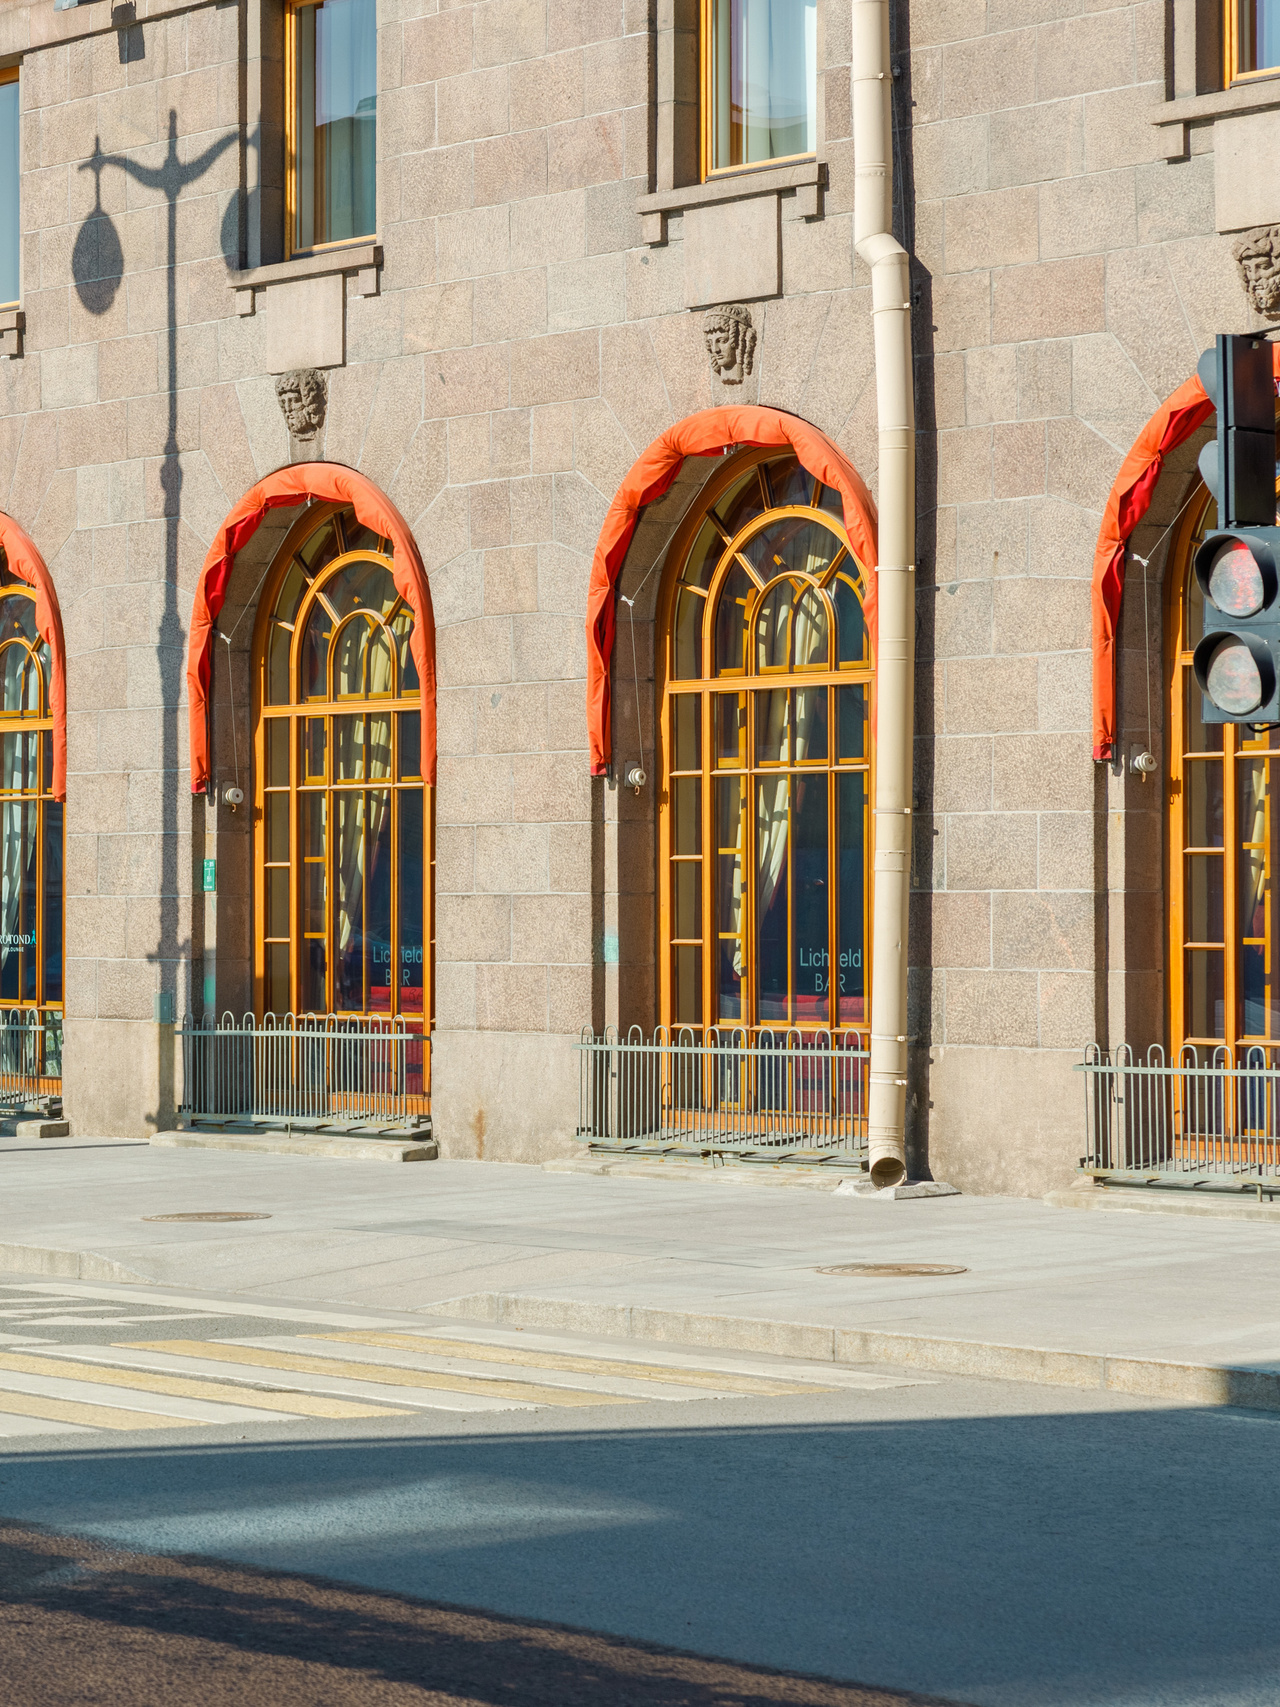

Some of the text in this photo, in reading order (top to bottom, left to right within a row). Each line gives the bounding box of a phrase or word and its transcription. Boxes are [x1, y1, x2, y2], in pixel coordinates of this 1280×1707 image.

[373, 946, 423, 963] Licield
[800, 948, 861, 967] Licheld
[385, 968, 410, 986] BR
